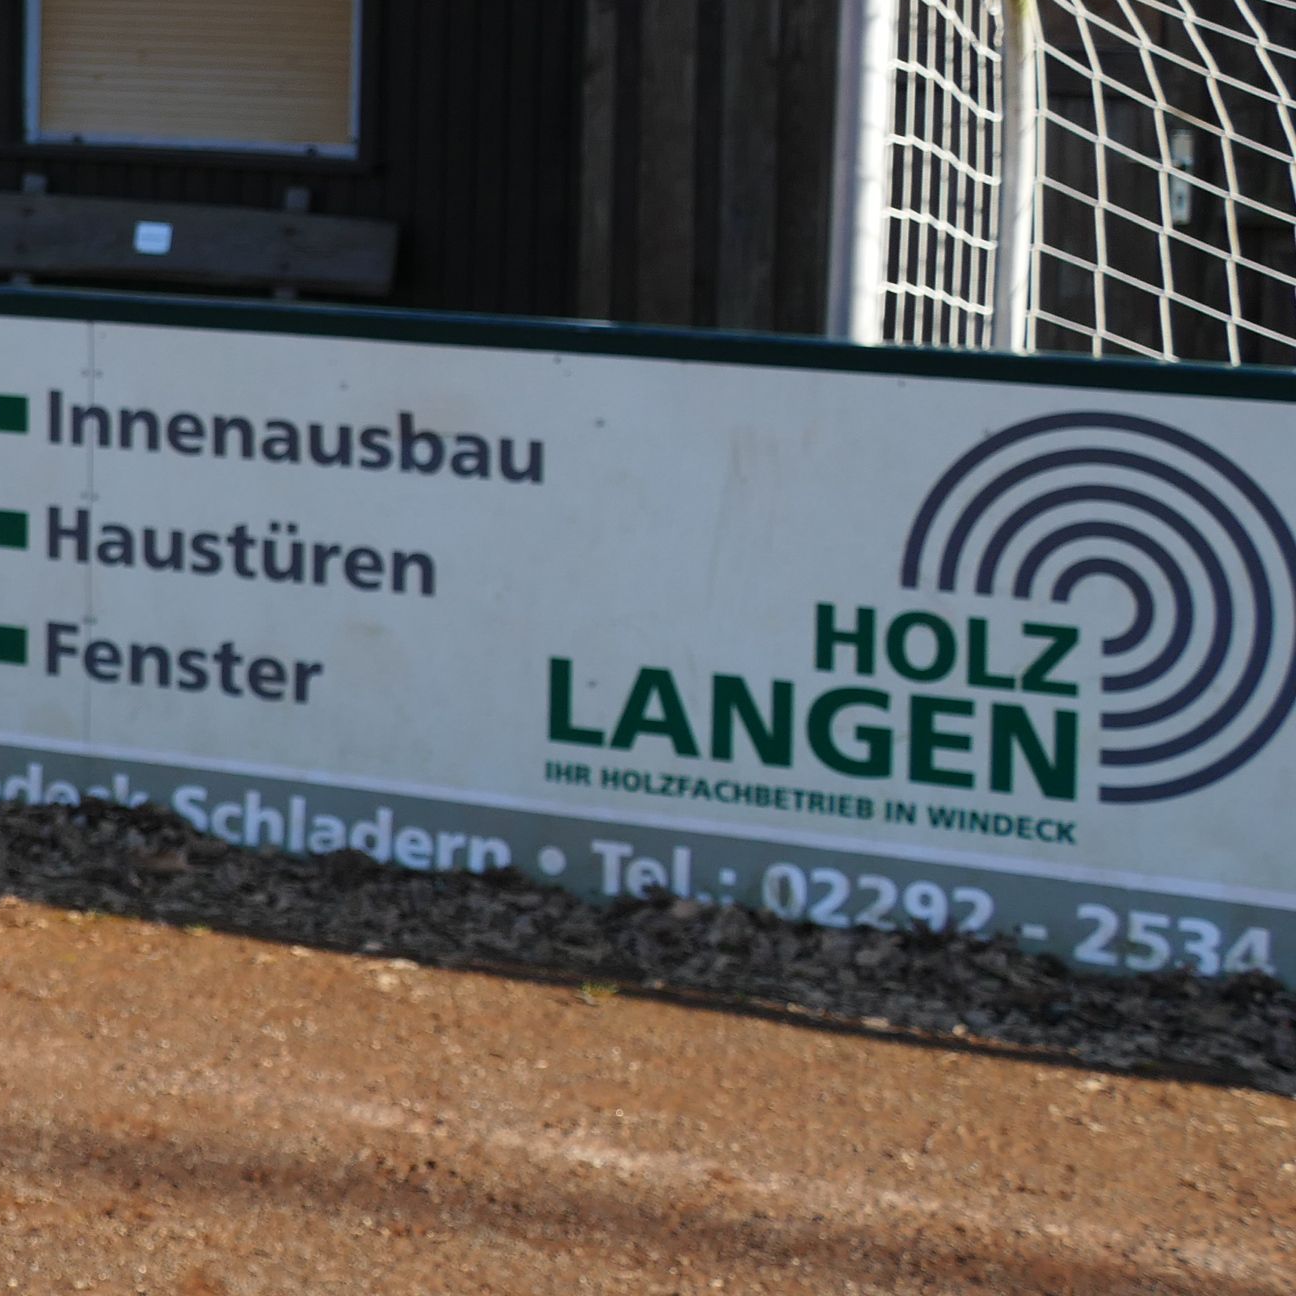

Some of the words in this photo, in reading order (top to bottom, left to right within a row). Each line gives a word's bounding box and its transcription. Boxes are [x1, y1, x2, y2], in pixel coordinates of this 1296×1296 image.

[47, 390, 544, 484] Innenausbau
[45, 506, 435, 596] Haustüren
[45, 622, 324, 704] Fenster
[815, 602, 1080, 698] HOLZ
[548, 657, 1078, 803] LANGEN
[545, 761, 592, 787] IHR
[600, 766, 874, 820] HOLZFACHBETRIEB
[885, 799, 917, 825] IN
[927, 803, 1077, 845] WINDECK
[171, 783, 511, 875] Schladern
[1073, 902, 1277, 978] 2534
